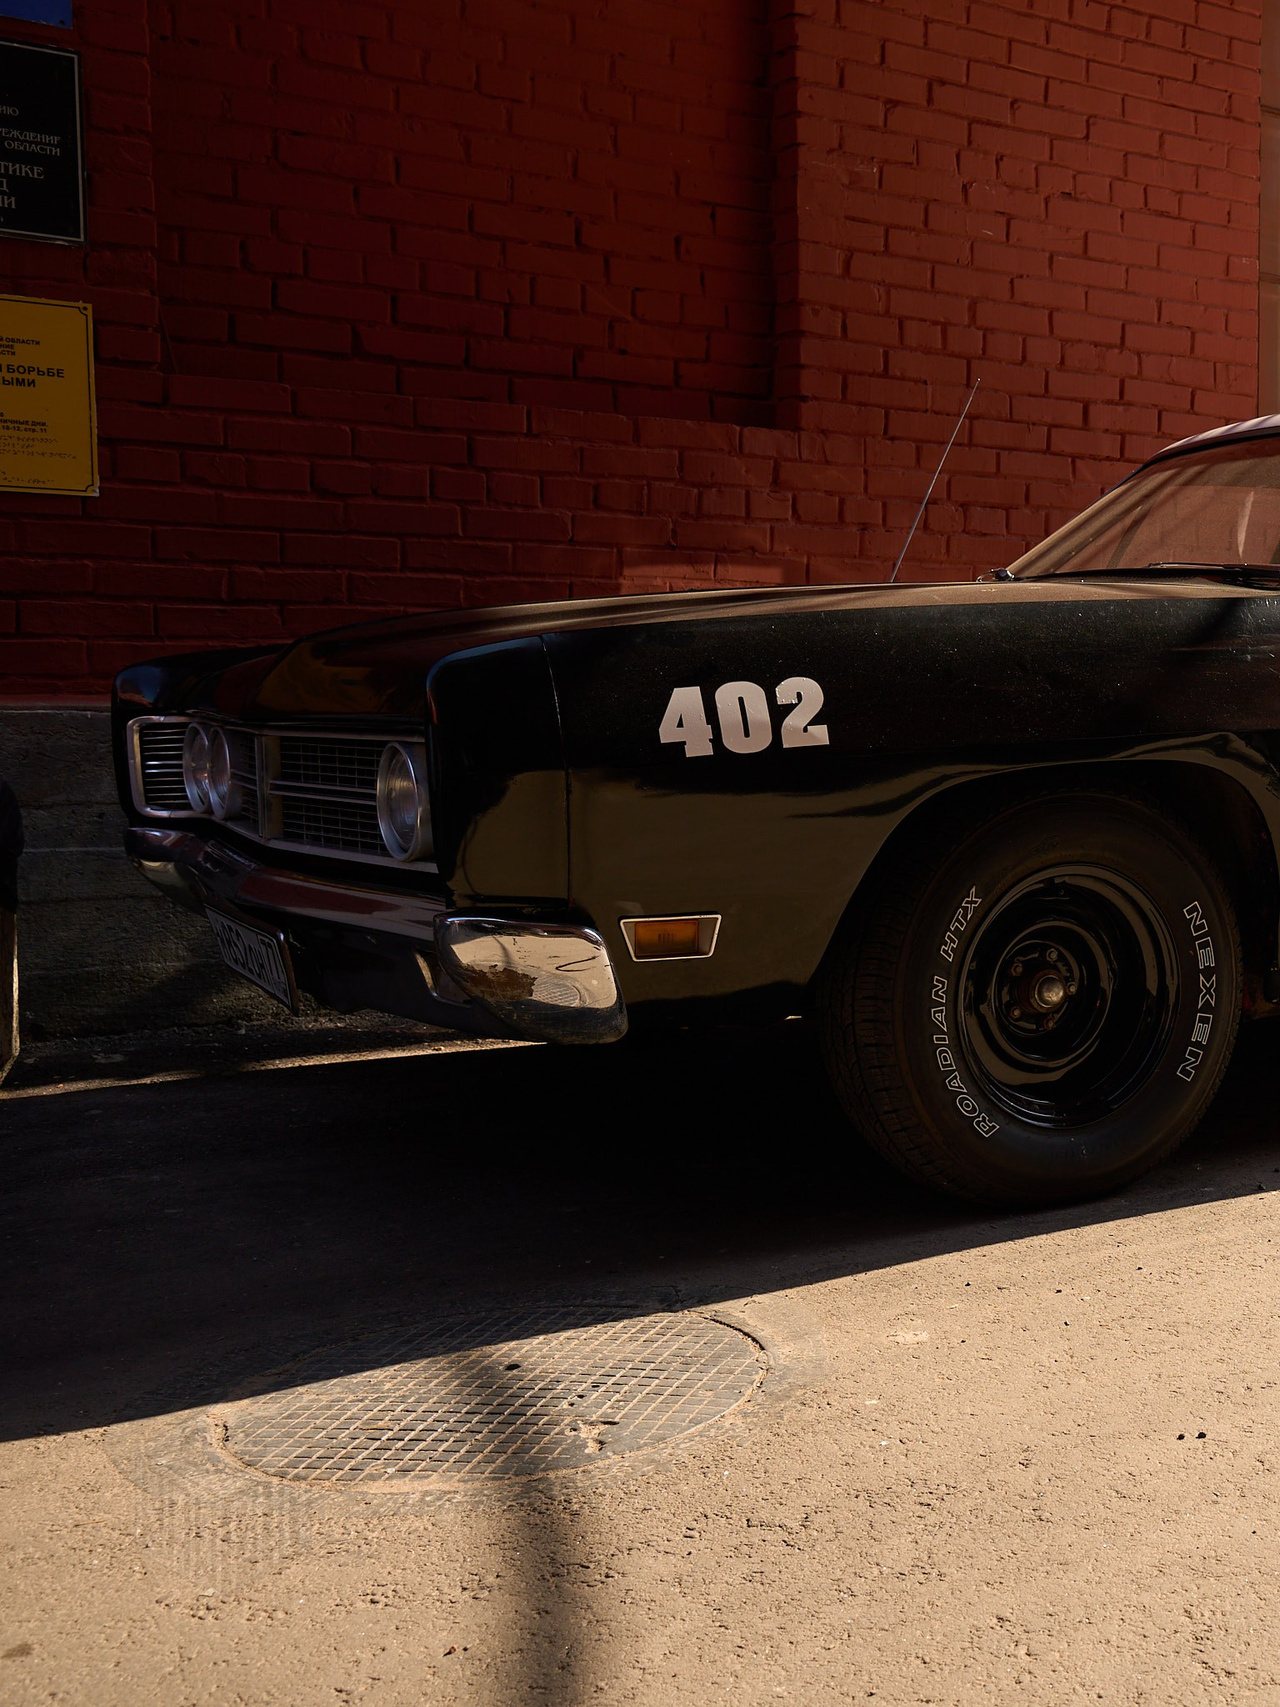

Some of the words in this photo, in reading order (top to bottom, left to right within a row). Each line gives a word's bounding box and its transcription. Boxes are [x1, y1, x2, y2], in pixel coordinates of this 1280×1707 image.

[0, 127, 61, 145] ЕЖДЕНИЕ
[4, 140, 61, 157] ОБЛАСТИ
[5, 337, 41, 346] ОБЛАСТИ
[6, 363, 65, 379] БОРЬБЕ
[659, 676, 830, 758] 402
[940, 885, 983, 962] HTX
[1176, 901, 1217, 1082] NEXEN
[931, 975, 1000, 1138] ROADIAN
